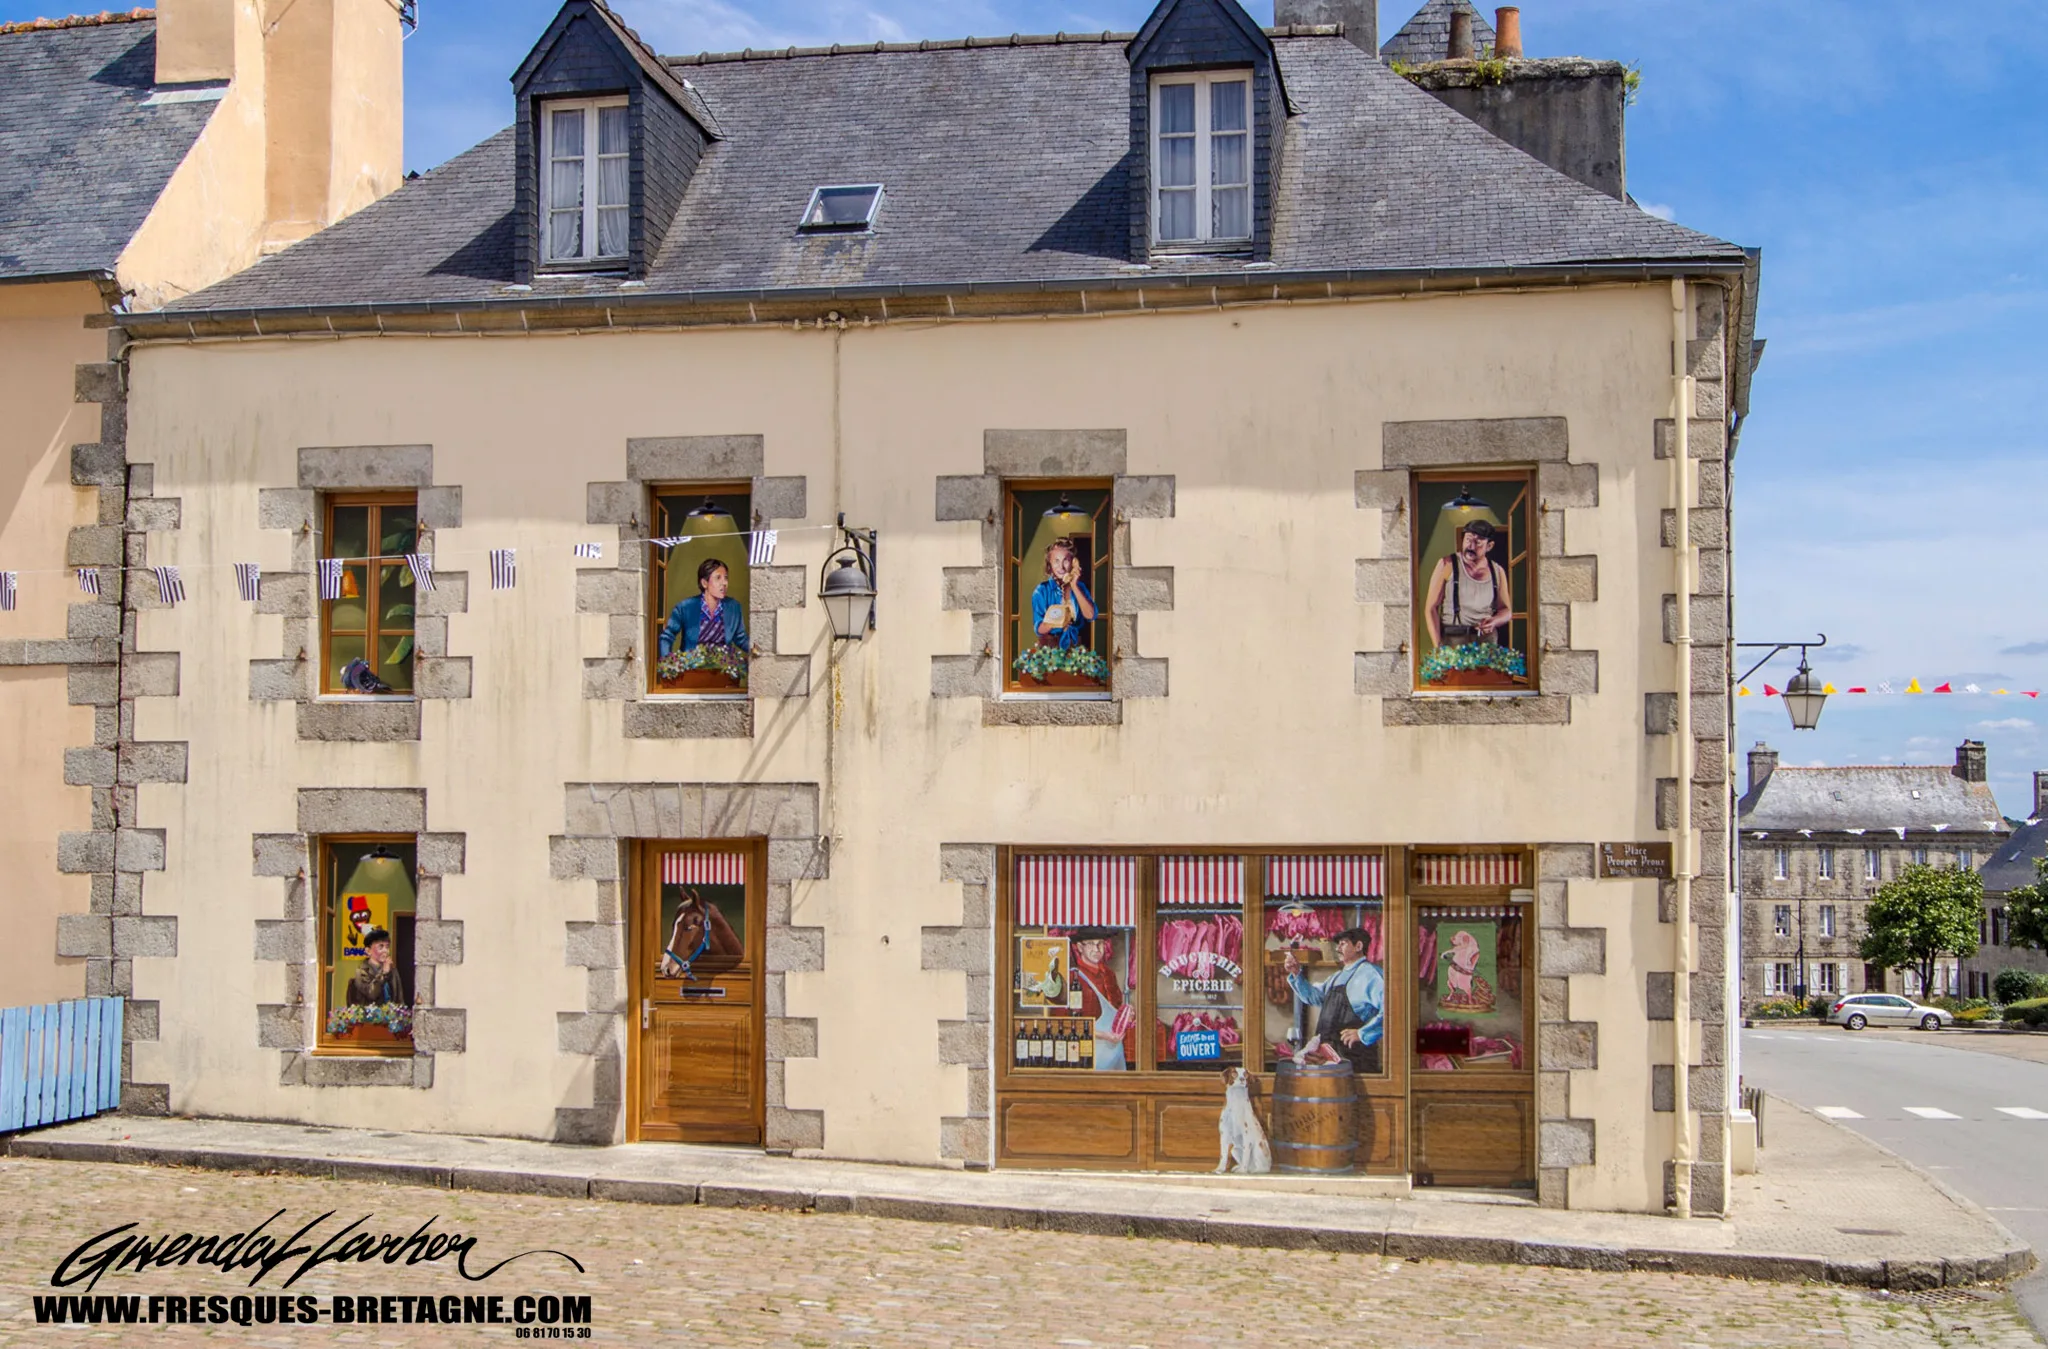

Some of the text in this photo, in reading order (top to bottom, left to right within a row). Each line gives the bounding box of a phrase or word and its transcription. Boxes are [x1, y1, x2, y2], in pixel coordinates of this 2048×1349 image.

[1624, 844, 1647, 856] Place
[1607, 855, 1664, 868] Prosper Proux
[1158, 952, 1242, 978] BOUCHERIE
[1173, 979, 1234, 992] EPICERIE
[1180, 1042, 1216, 1057] OUVERT
